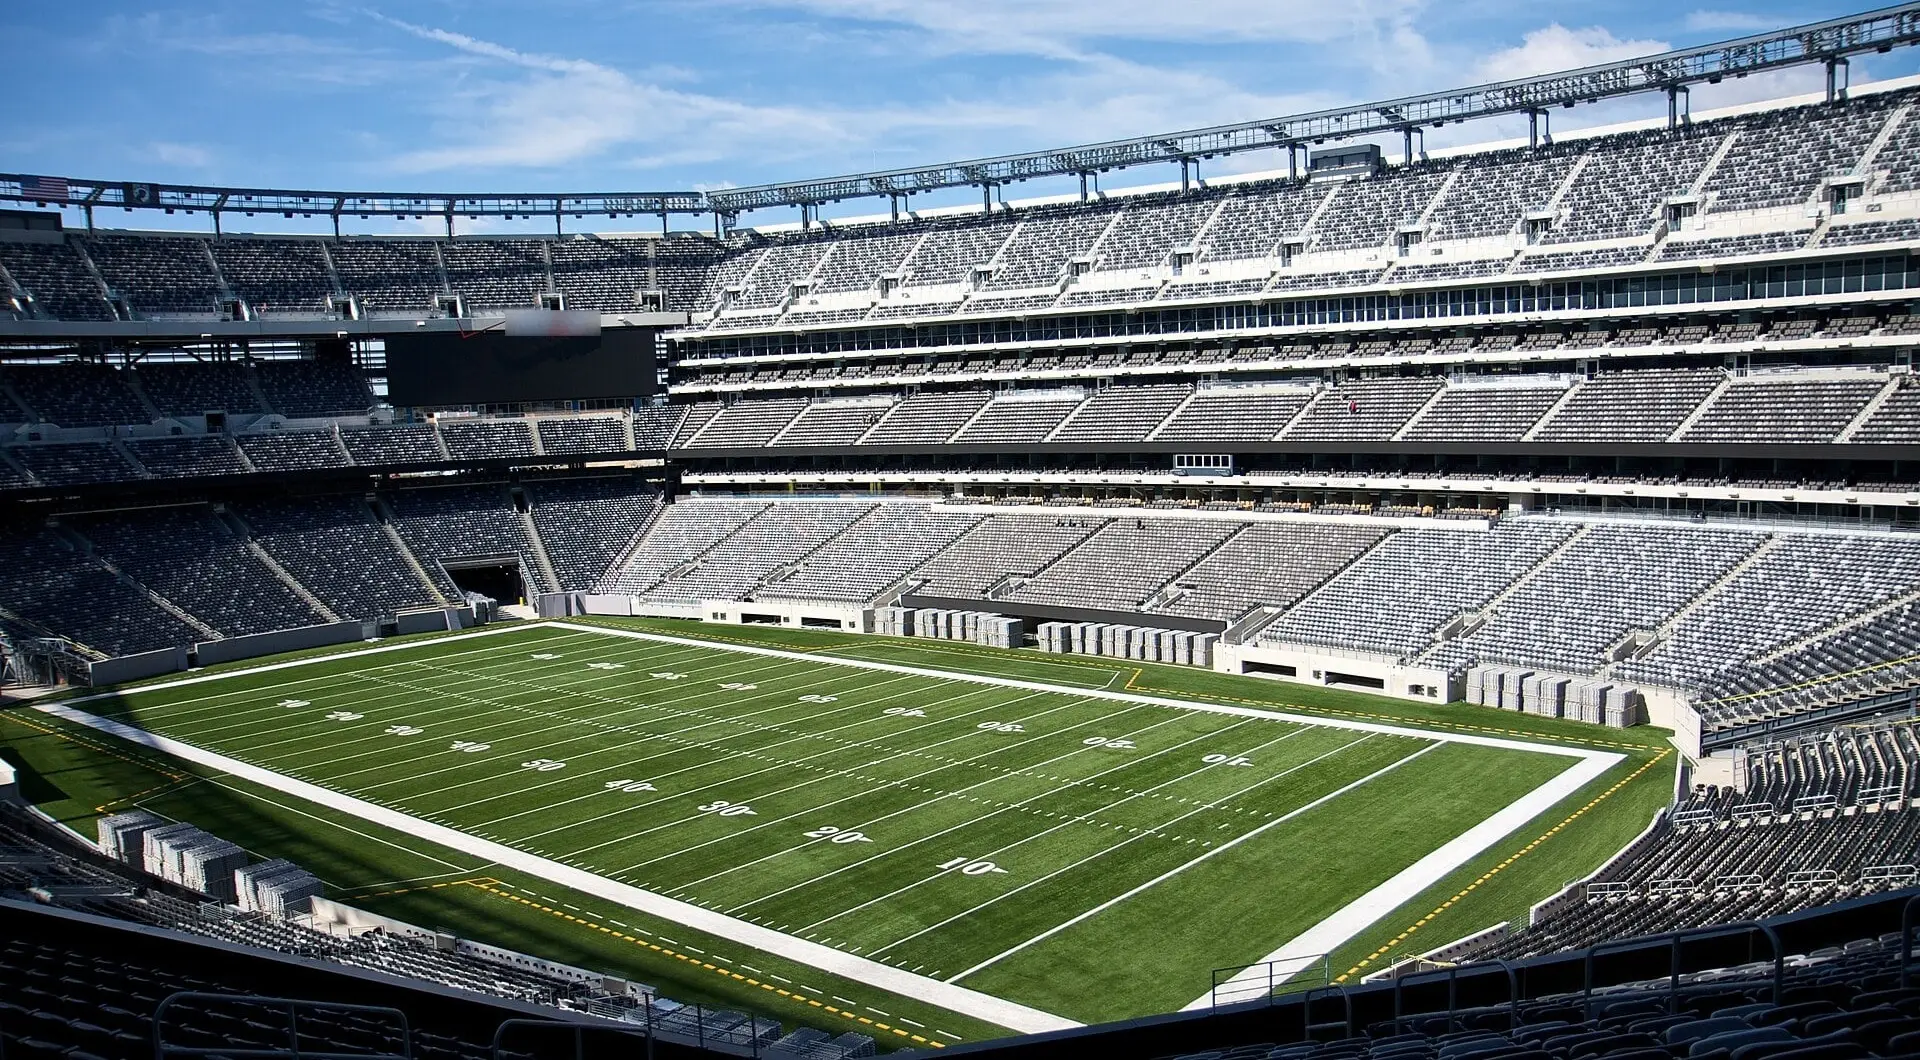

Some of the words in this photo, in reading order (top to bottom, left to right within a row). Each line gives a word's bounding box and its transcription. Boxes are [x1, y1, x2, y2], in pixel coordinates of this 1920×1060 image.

[1082, 736, 1134, 748] 20
[521, 758, 567, 771] 50
[1201, 753, 1250, 765] 10
[605, 779, 652, 792] 40
[697, 801, 750, 816] 30
[803, 826, 864, 843] 20
[936, 857, 996, 875] 10
